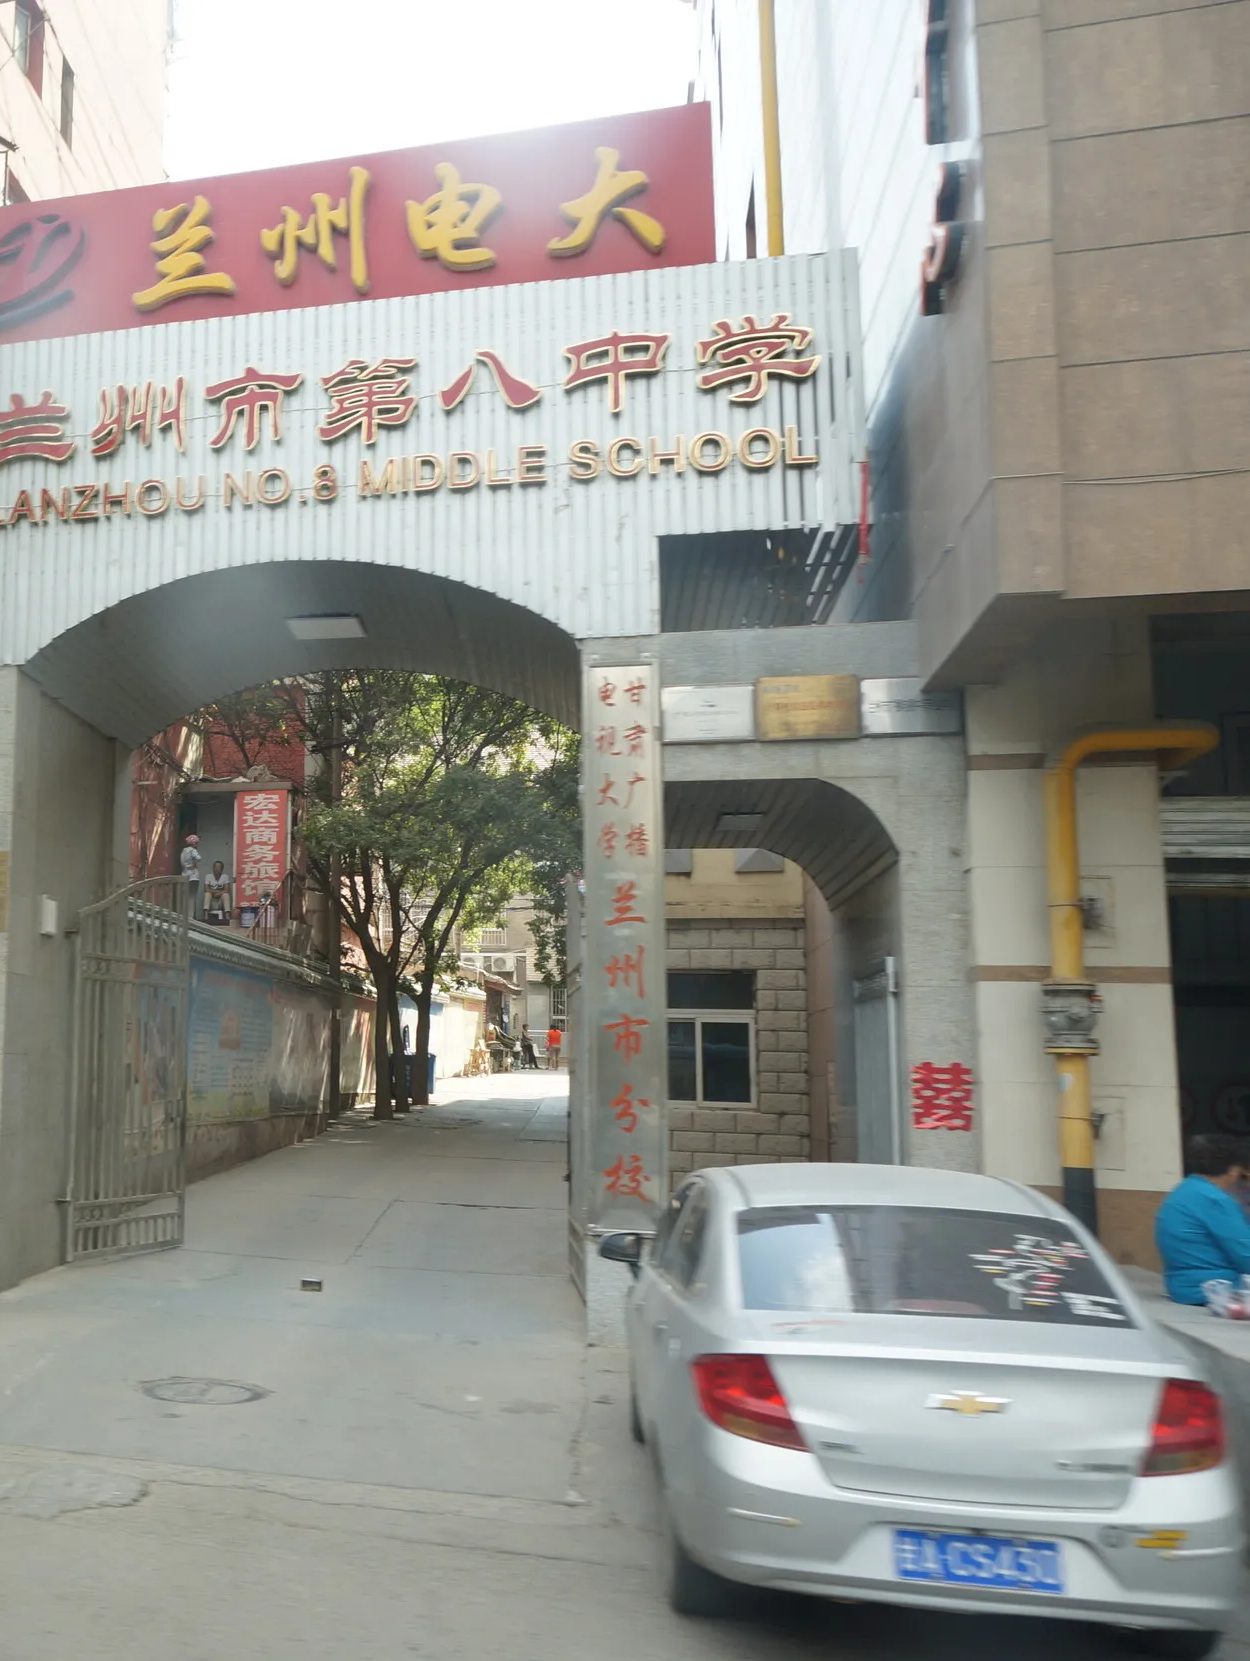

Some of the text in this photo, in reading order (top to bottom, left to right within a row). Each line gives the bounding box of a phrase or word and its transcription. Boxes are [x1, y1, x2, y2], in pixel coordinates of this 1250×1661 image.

[132, 146, 666, 312] 兰州电大
[358, 443, 548, 499] MIDDLE
[568, 424, 821, 480] SCHOOL
[603, 880, 651, 1204] 兰州市分校
